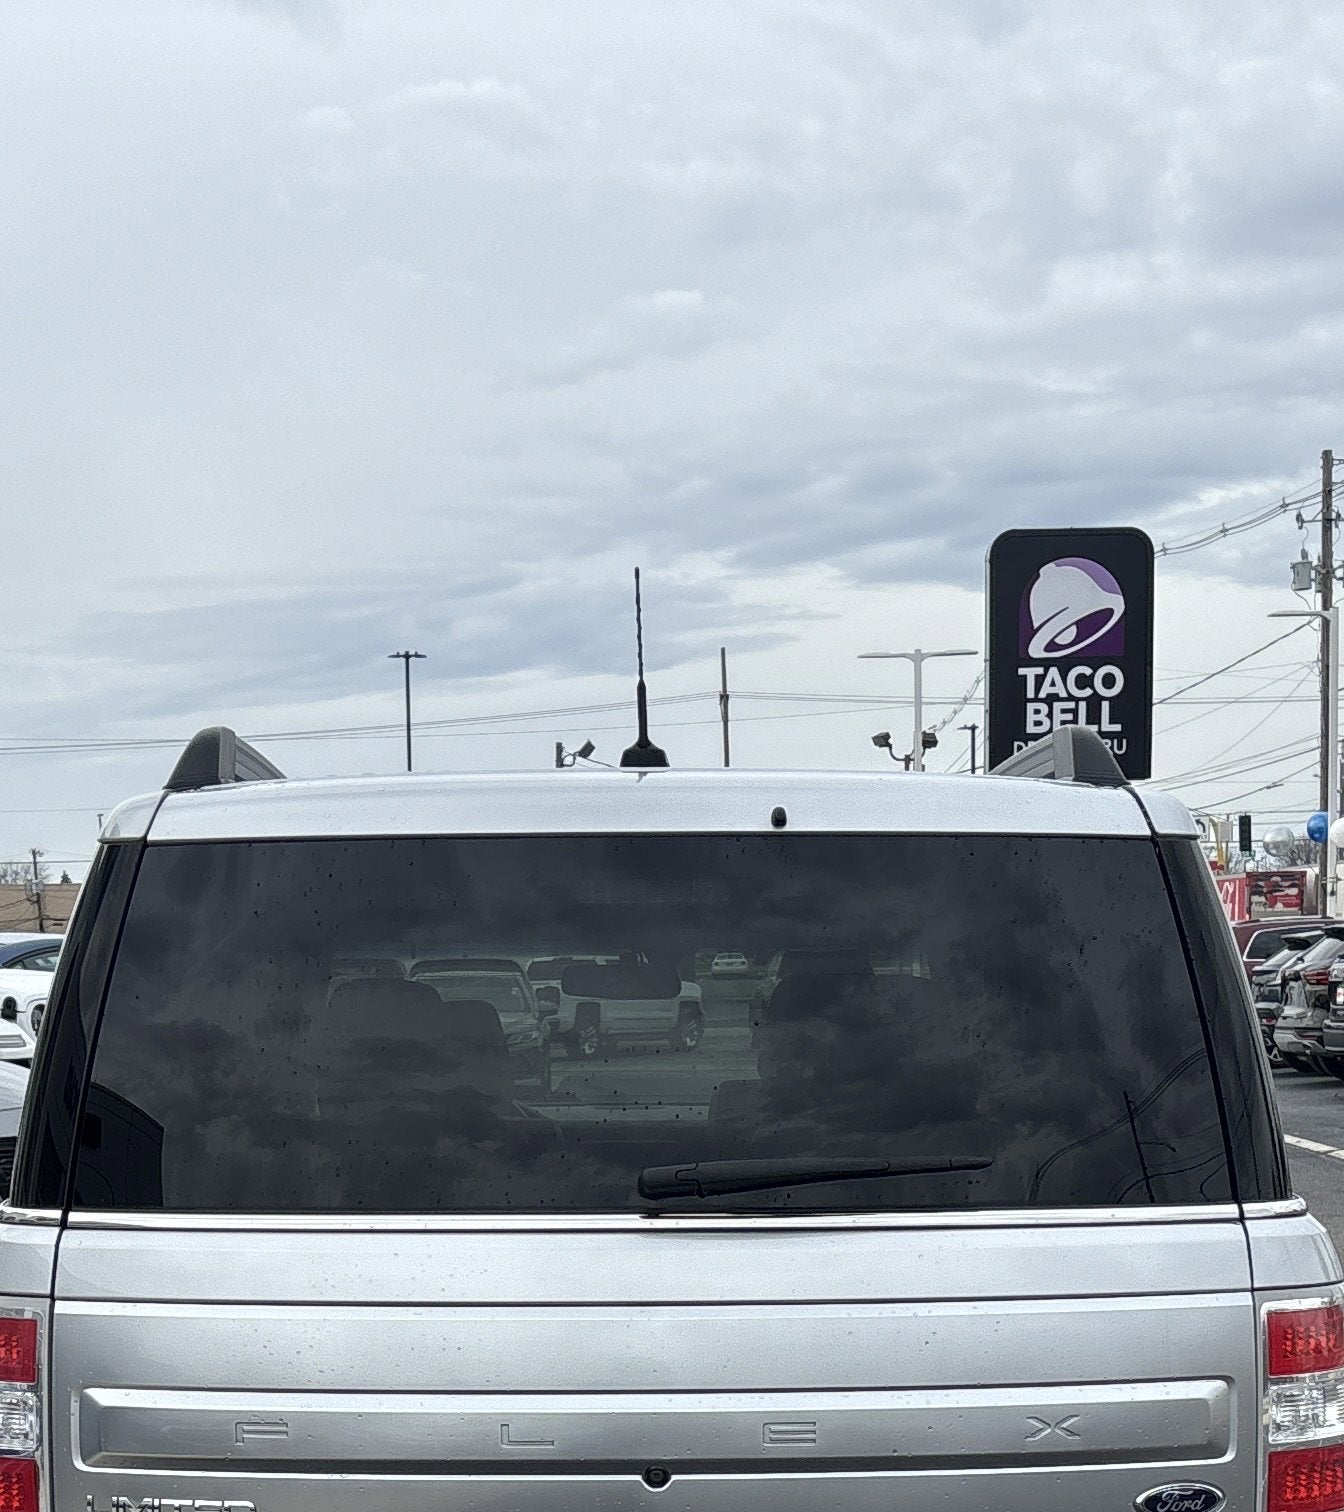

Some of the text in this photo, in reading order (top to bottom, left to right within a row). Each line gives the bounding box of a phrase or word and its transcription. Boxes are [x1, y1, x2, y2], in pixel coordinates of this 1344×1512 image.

[1017, 664, 1125, 699] TACO
[1025, 701, 1122, 734] BELL
[234, 1414, 1081, 1448] FLEX
[1156, 1490, 1206, 1512] Ford
